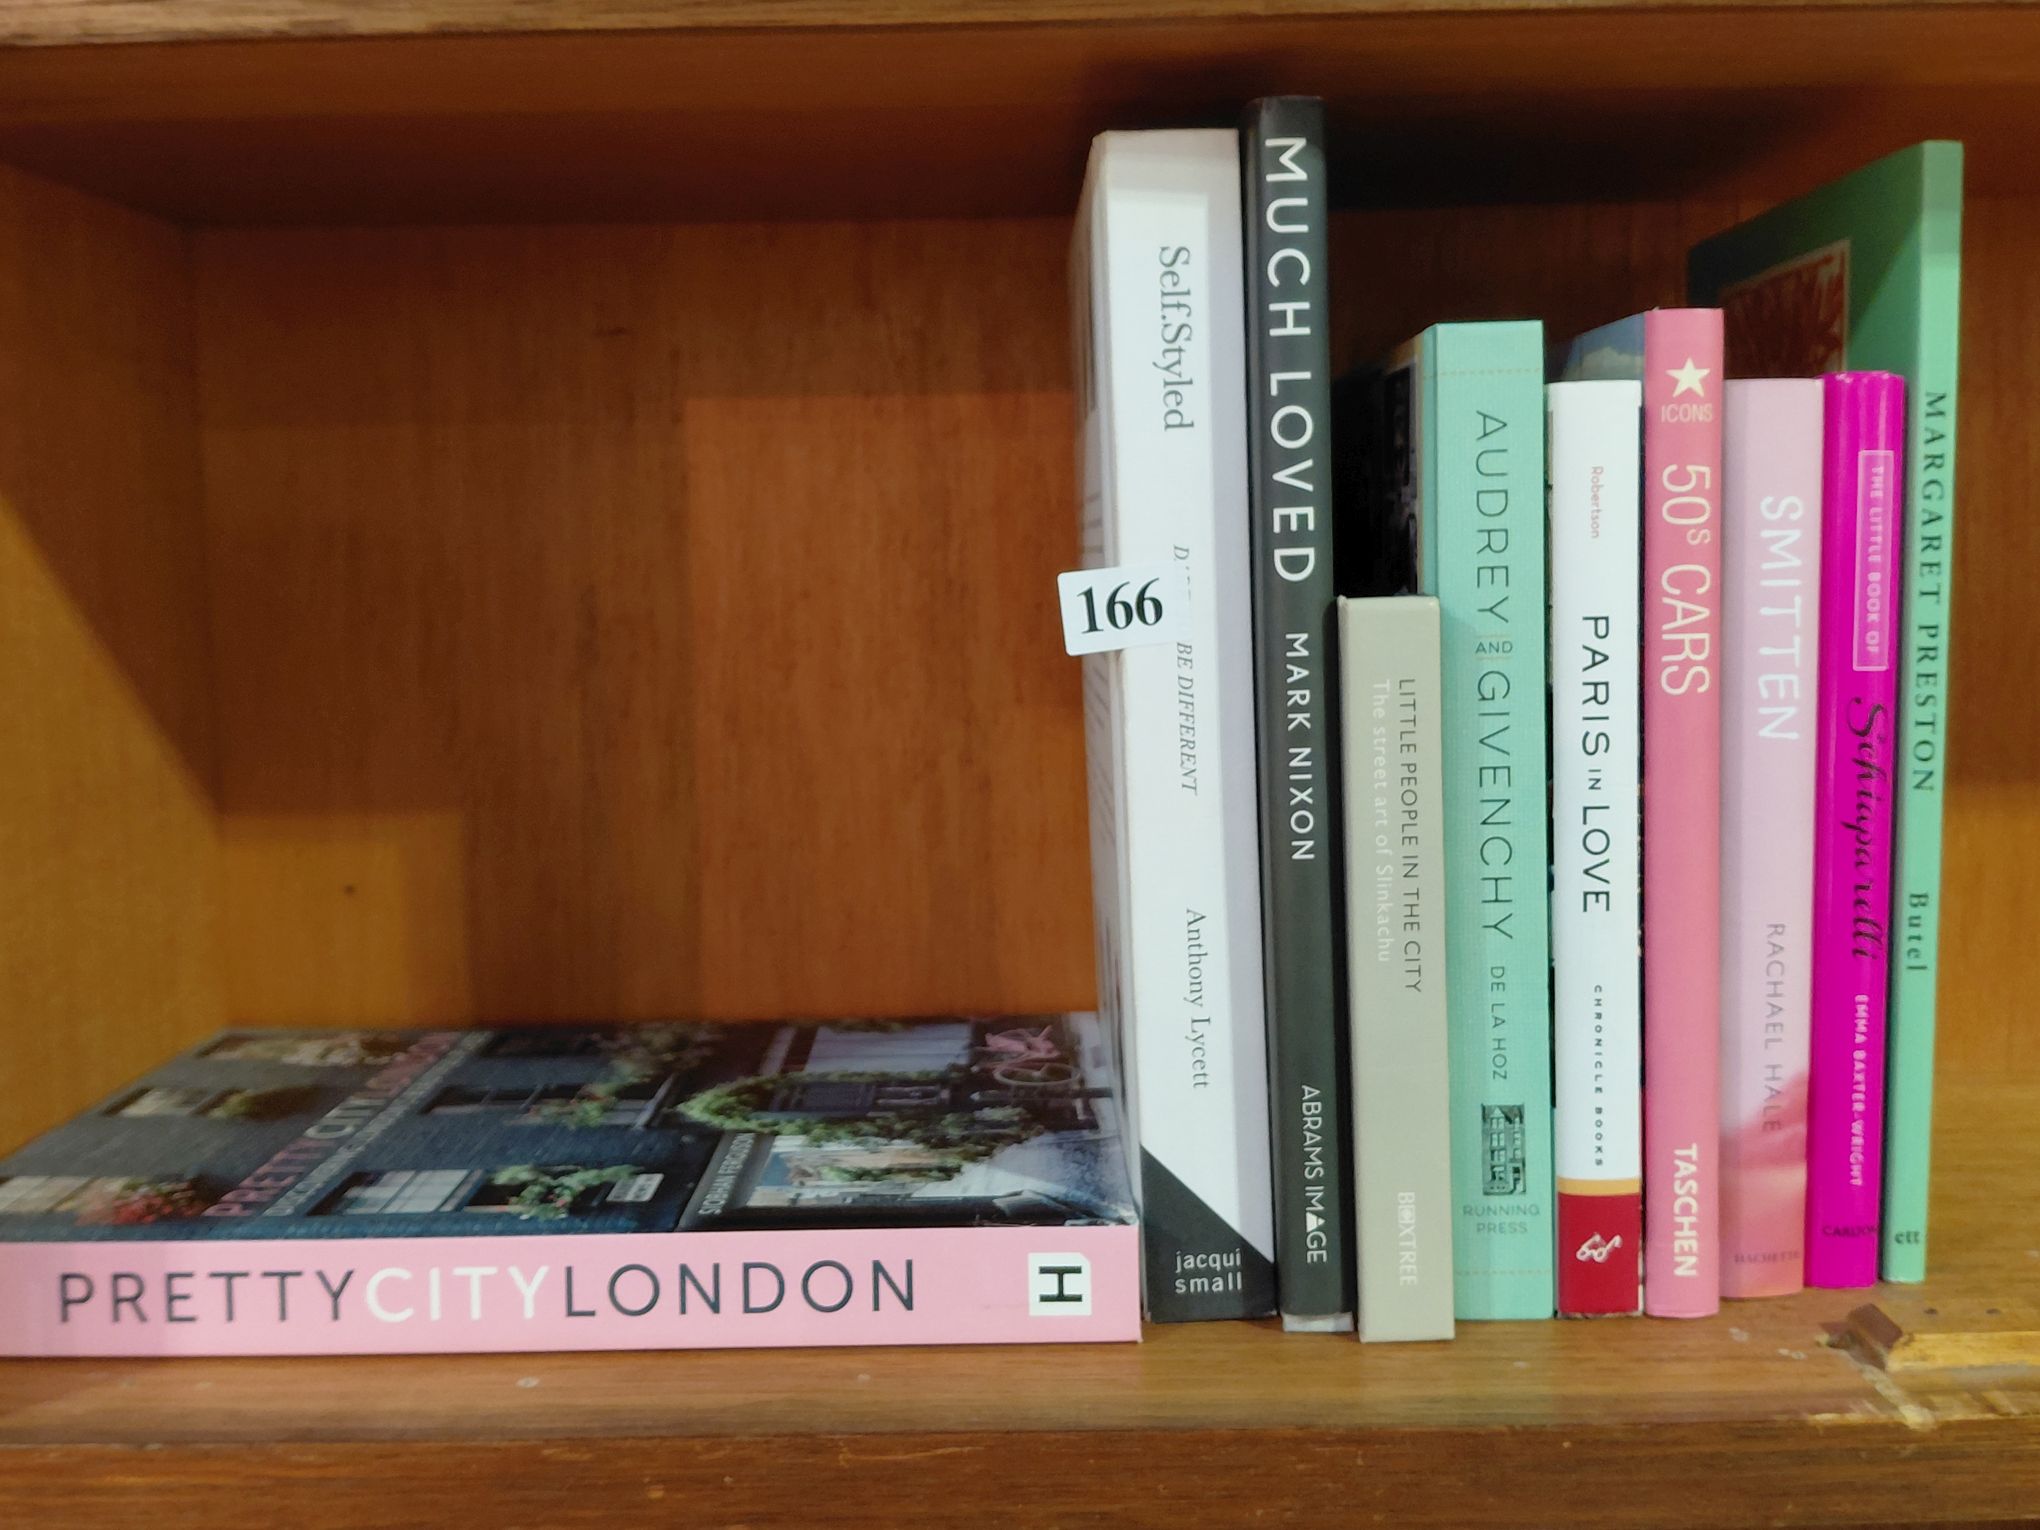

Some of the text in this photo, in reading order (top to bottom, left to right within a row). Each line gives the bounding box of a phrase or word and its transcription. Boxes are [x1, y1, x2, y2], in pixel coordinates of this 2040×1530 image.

[1152, 245, 1194, 432] Self.Styled
[1265, 137, 1316, 583] MUCH LOVED
[1660, 403, 1713, 423] ICONS
[1589, 466, 1604, 539] Robertson
[1866, 466, 1885, 653] THE LITTLE BOOK OF
[1912, 391, 1948, 791] MARGARET PRESTON
[1077, 578, 1164, 634] 166
[1475, 410, 1515, 940] AUDREY AND GIVENCHY
[1661, 563, 1711, 696] CARS
[1758, 496, 1804, 741] SMITTEN
[1176, 642, 1198, 796] BE DIFFERENT
[1285, 632, 1315, 861] MARK NIXON
[1581, 615, 1611, 913] PARIS IN LOVE
[1372, 679, 1395, 962] The street art of Slinkachu
[1399, 679, 1422, 992] LITTLE PEOPLE IN THE CITY
[1841, 697, 1887, 960] Schiaparelli
[1184, 908, 1210, 1089] Anthony Lycett
[1854, 994, 1869, 1044] EMMA
[1907, 893, 1929, 970] Butel
[1489, 965, 1508, 1081] DE LA HOZ
[1593, 985, 1604, 1167] CHRONICLE BOOKS
[1762, 922, 1786, 1133] RACHAEL HALE
[1175, 1249, 1242, 1274] jacqui
[1301, 1085, 1327, 1264] ABRAMS IMAGE
[1398, 1191, 1418, 1286] BOXTREE
[1462, 1204, 1540, 1217] RUNNING
[1476, 1222, 1528, 1234] PRESS
[1673, 1143, 1699, 1277] TASCHEN
[1175, 1275, 1243, 1295] small
